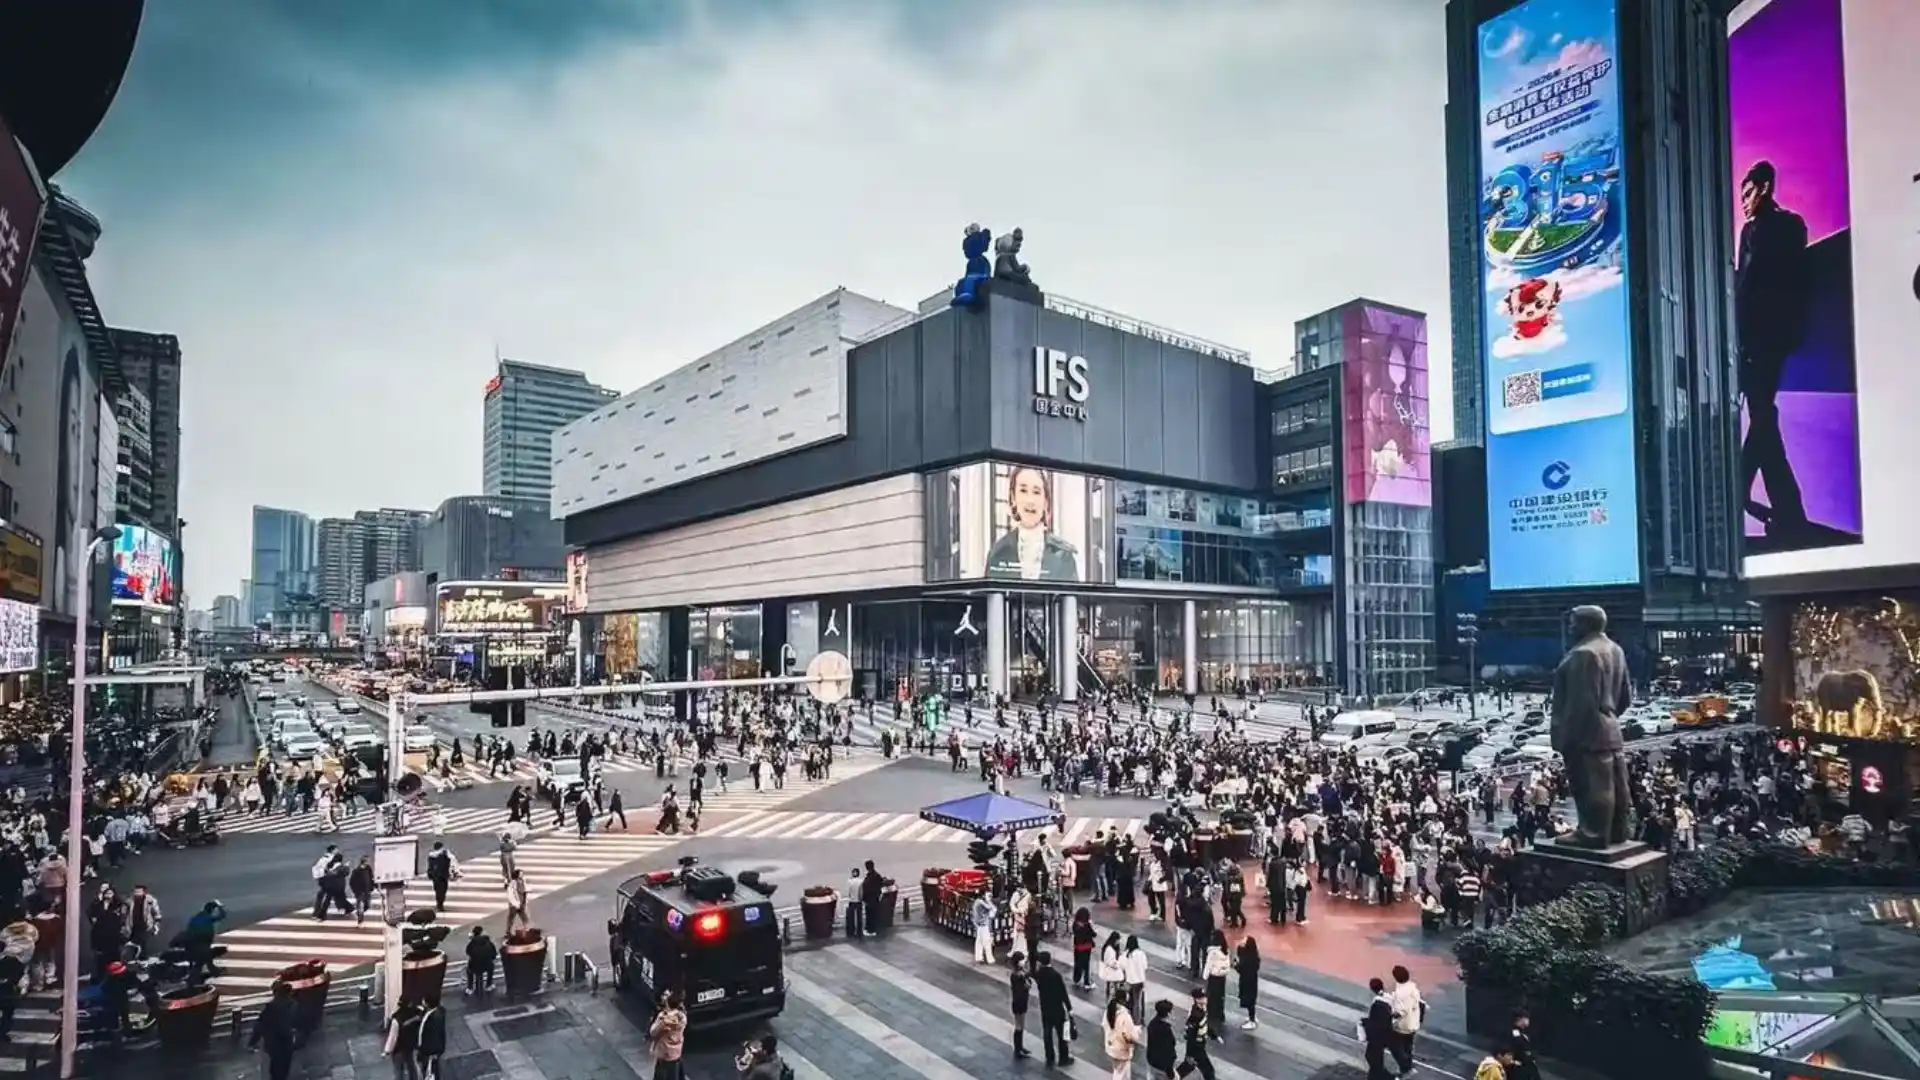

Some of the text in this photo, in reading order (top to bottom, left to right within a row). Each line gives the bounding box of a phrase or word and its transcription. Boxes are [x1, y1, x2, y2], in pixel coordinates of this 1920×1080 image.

[1036, 346, 1089, 402] IFS
[1036, 397, 1089, 421] 国金中心
[1508, 489, 1608, 508] 中国建设银行
